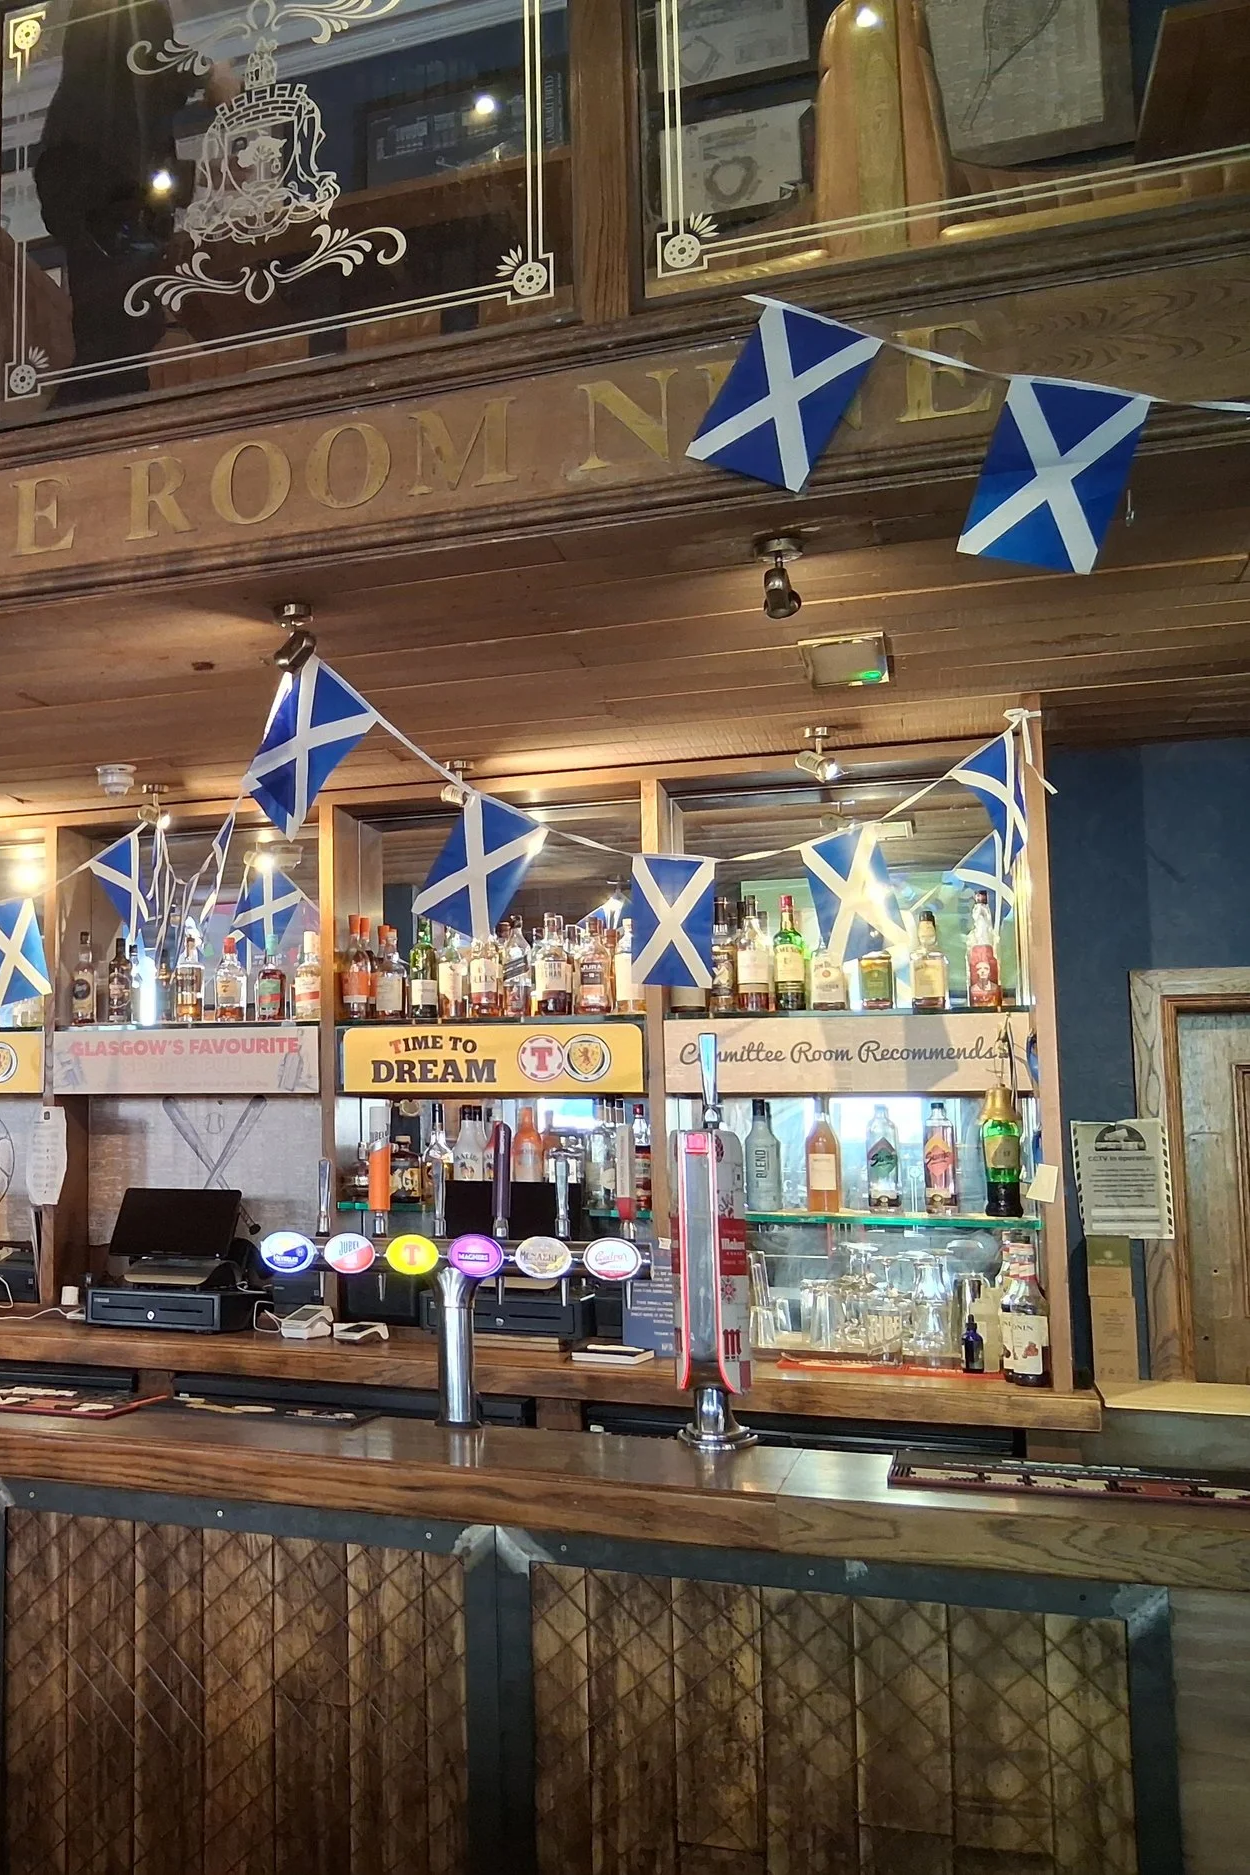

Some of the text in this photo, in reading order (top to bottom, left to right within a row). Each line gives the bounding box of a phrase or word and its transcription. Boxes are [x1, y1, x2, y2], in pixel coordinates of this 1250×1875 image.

[123, 396, 519, 542] ROOM
[577, 320, 993, 472] NE
[580, 963, 603, 971] JURA
[70, 1036, 300, 1057] GLASGOW'S FAVOURITE
[388, 1034, 478, 1055] TIME TO
[790, 1041, 853, 1065] Room
[530, 1045, 554, 1072] T
[371, 1058, 497, 1084] DREAM
[1118, 1154, 1155, 1163] operation
[403, 1244, 421, 1266] T
[457, 1252, 490, 1262] MAGNERS
